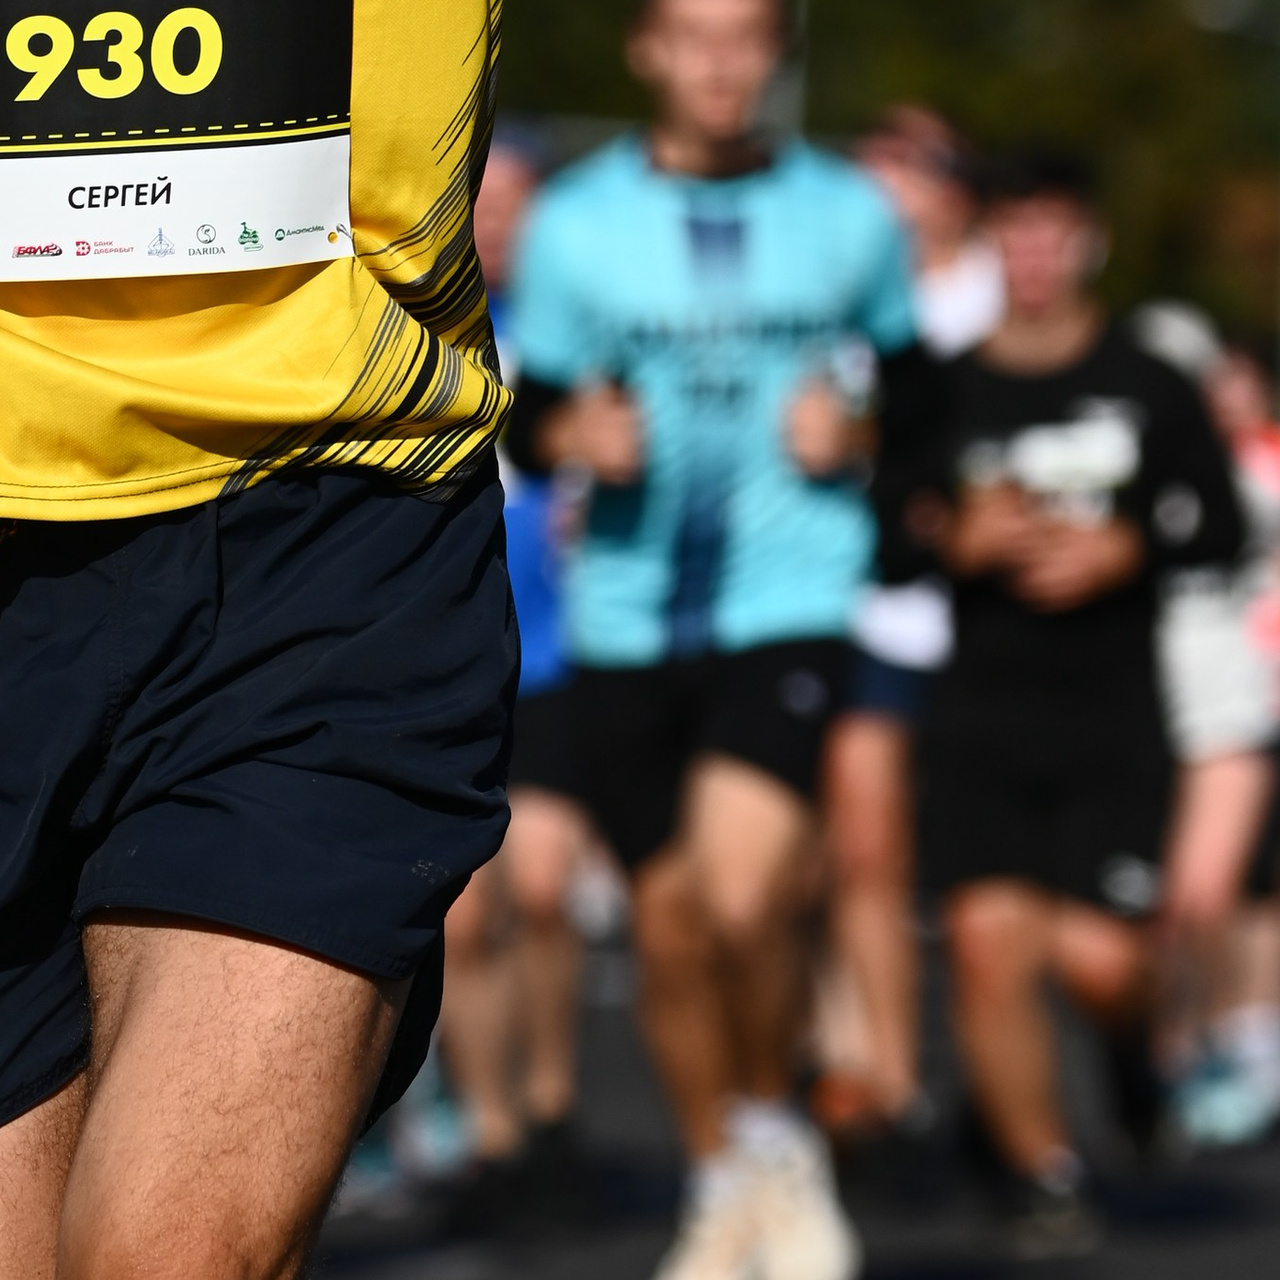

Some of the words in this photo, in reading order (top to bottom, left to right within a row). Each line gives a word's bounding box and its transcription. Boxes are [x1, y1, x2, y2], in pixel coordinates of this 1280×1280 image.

[5, 7, 223, 102] 930
[67, 175, 172, 210] СЕРГЕЙ
[188, 246, 226, 256] DARIDA
